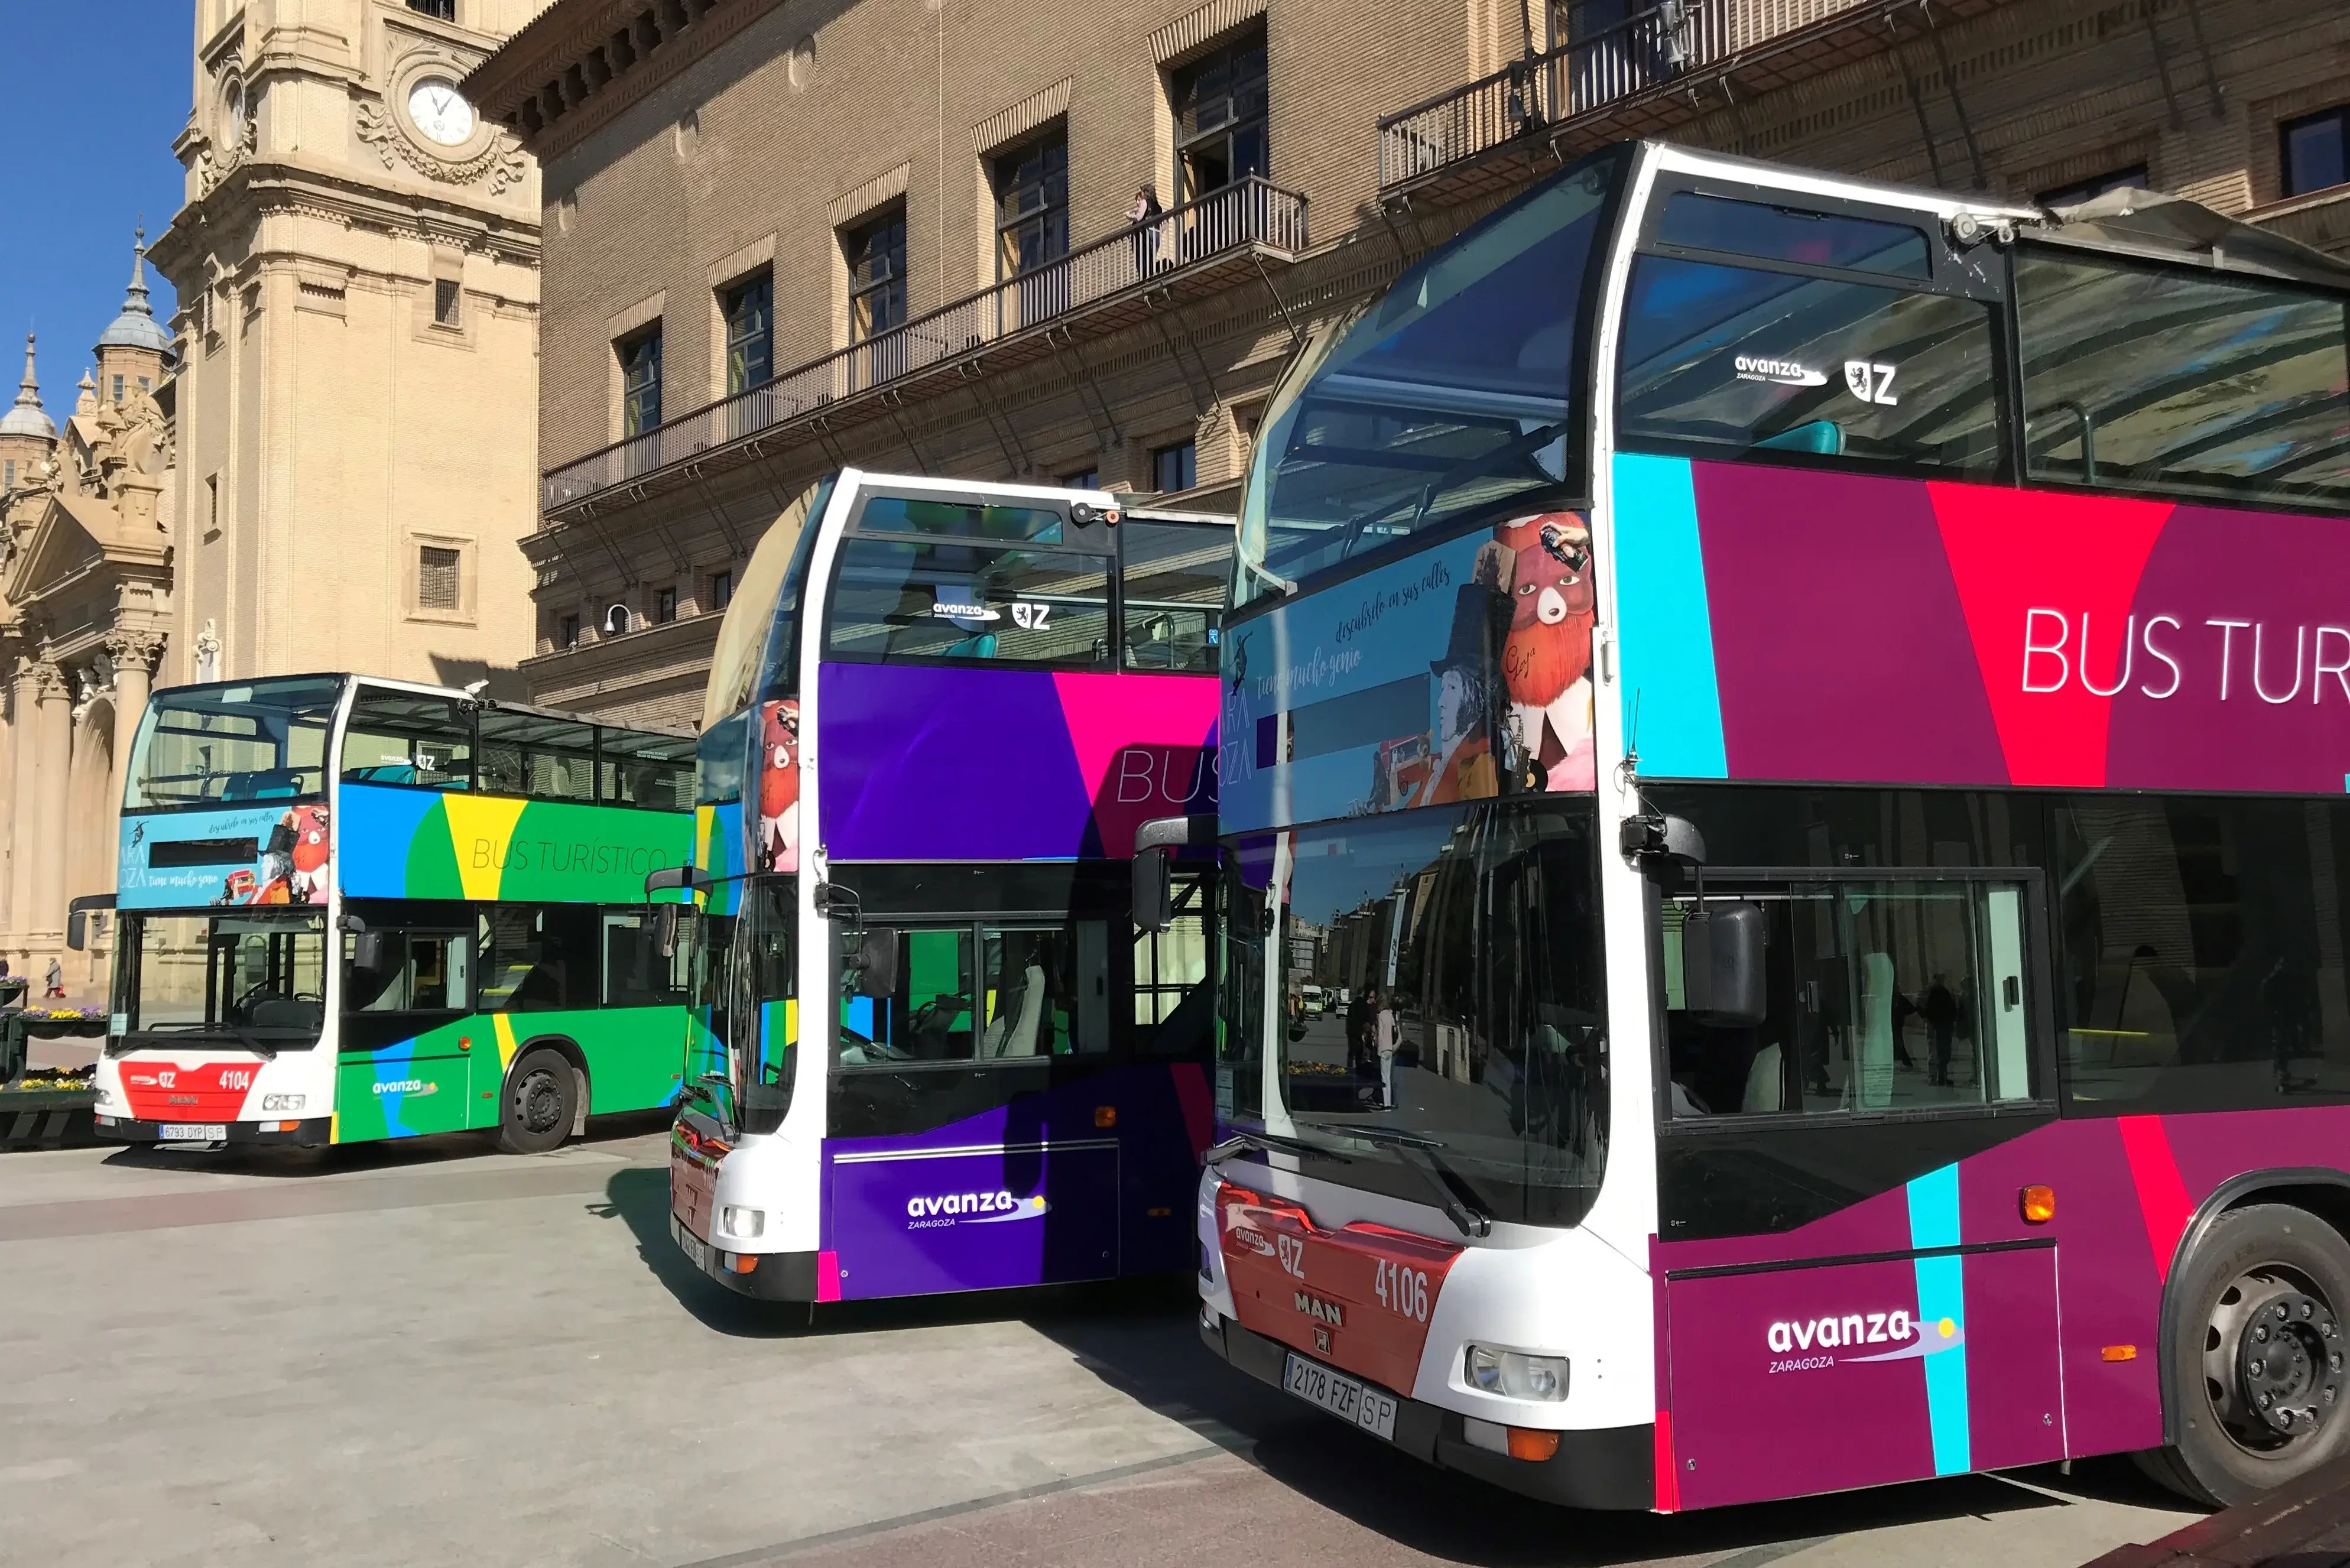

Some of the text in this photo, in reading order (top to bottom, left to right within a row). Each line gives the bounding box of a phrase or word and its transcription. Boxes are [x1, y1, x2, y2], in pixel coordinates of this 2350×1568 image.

[1735, 356, 1802, 377] avanza
[1736, 372, 1766, 381] ZARAGOZA
[933, 603, 982, 615] avanza
[1336, 560, 1450, 643] descubrelo en sus calles
[1287, 646, 1326, 690] mucho
[1329, 648, 1363, 687] genio
[1506, 645, 1536, 681] Goya
[2023, 609, 2350, 705] BUS TUR
[472, 837, 667, 875] BUS TURÍSTICO
[219, 1070, 251, 1090] 4104
[372, 1079, 421, 1094] avanza
[165, 1127, 184, 1138] 6793
[188, 1127, 202, 1138] DYP
[907, 1191, 1013, 1217] avanza
[907, 1218, 955, 1229] ZARAGOZA
[1236, 1226, 1264, 1248] avanza
[1375, 1259, 1428, 1323] 4106
[1294, 1291, 1344, 1327] MAN
[1768, 1310, 1911, 1353] avanza
[1769, 1355, 1834, 1374] ZARAGOZA
[1294, 1364, 1326, 1401] 2178
[1330, 1379, 1358, 1413] FZF
